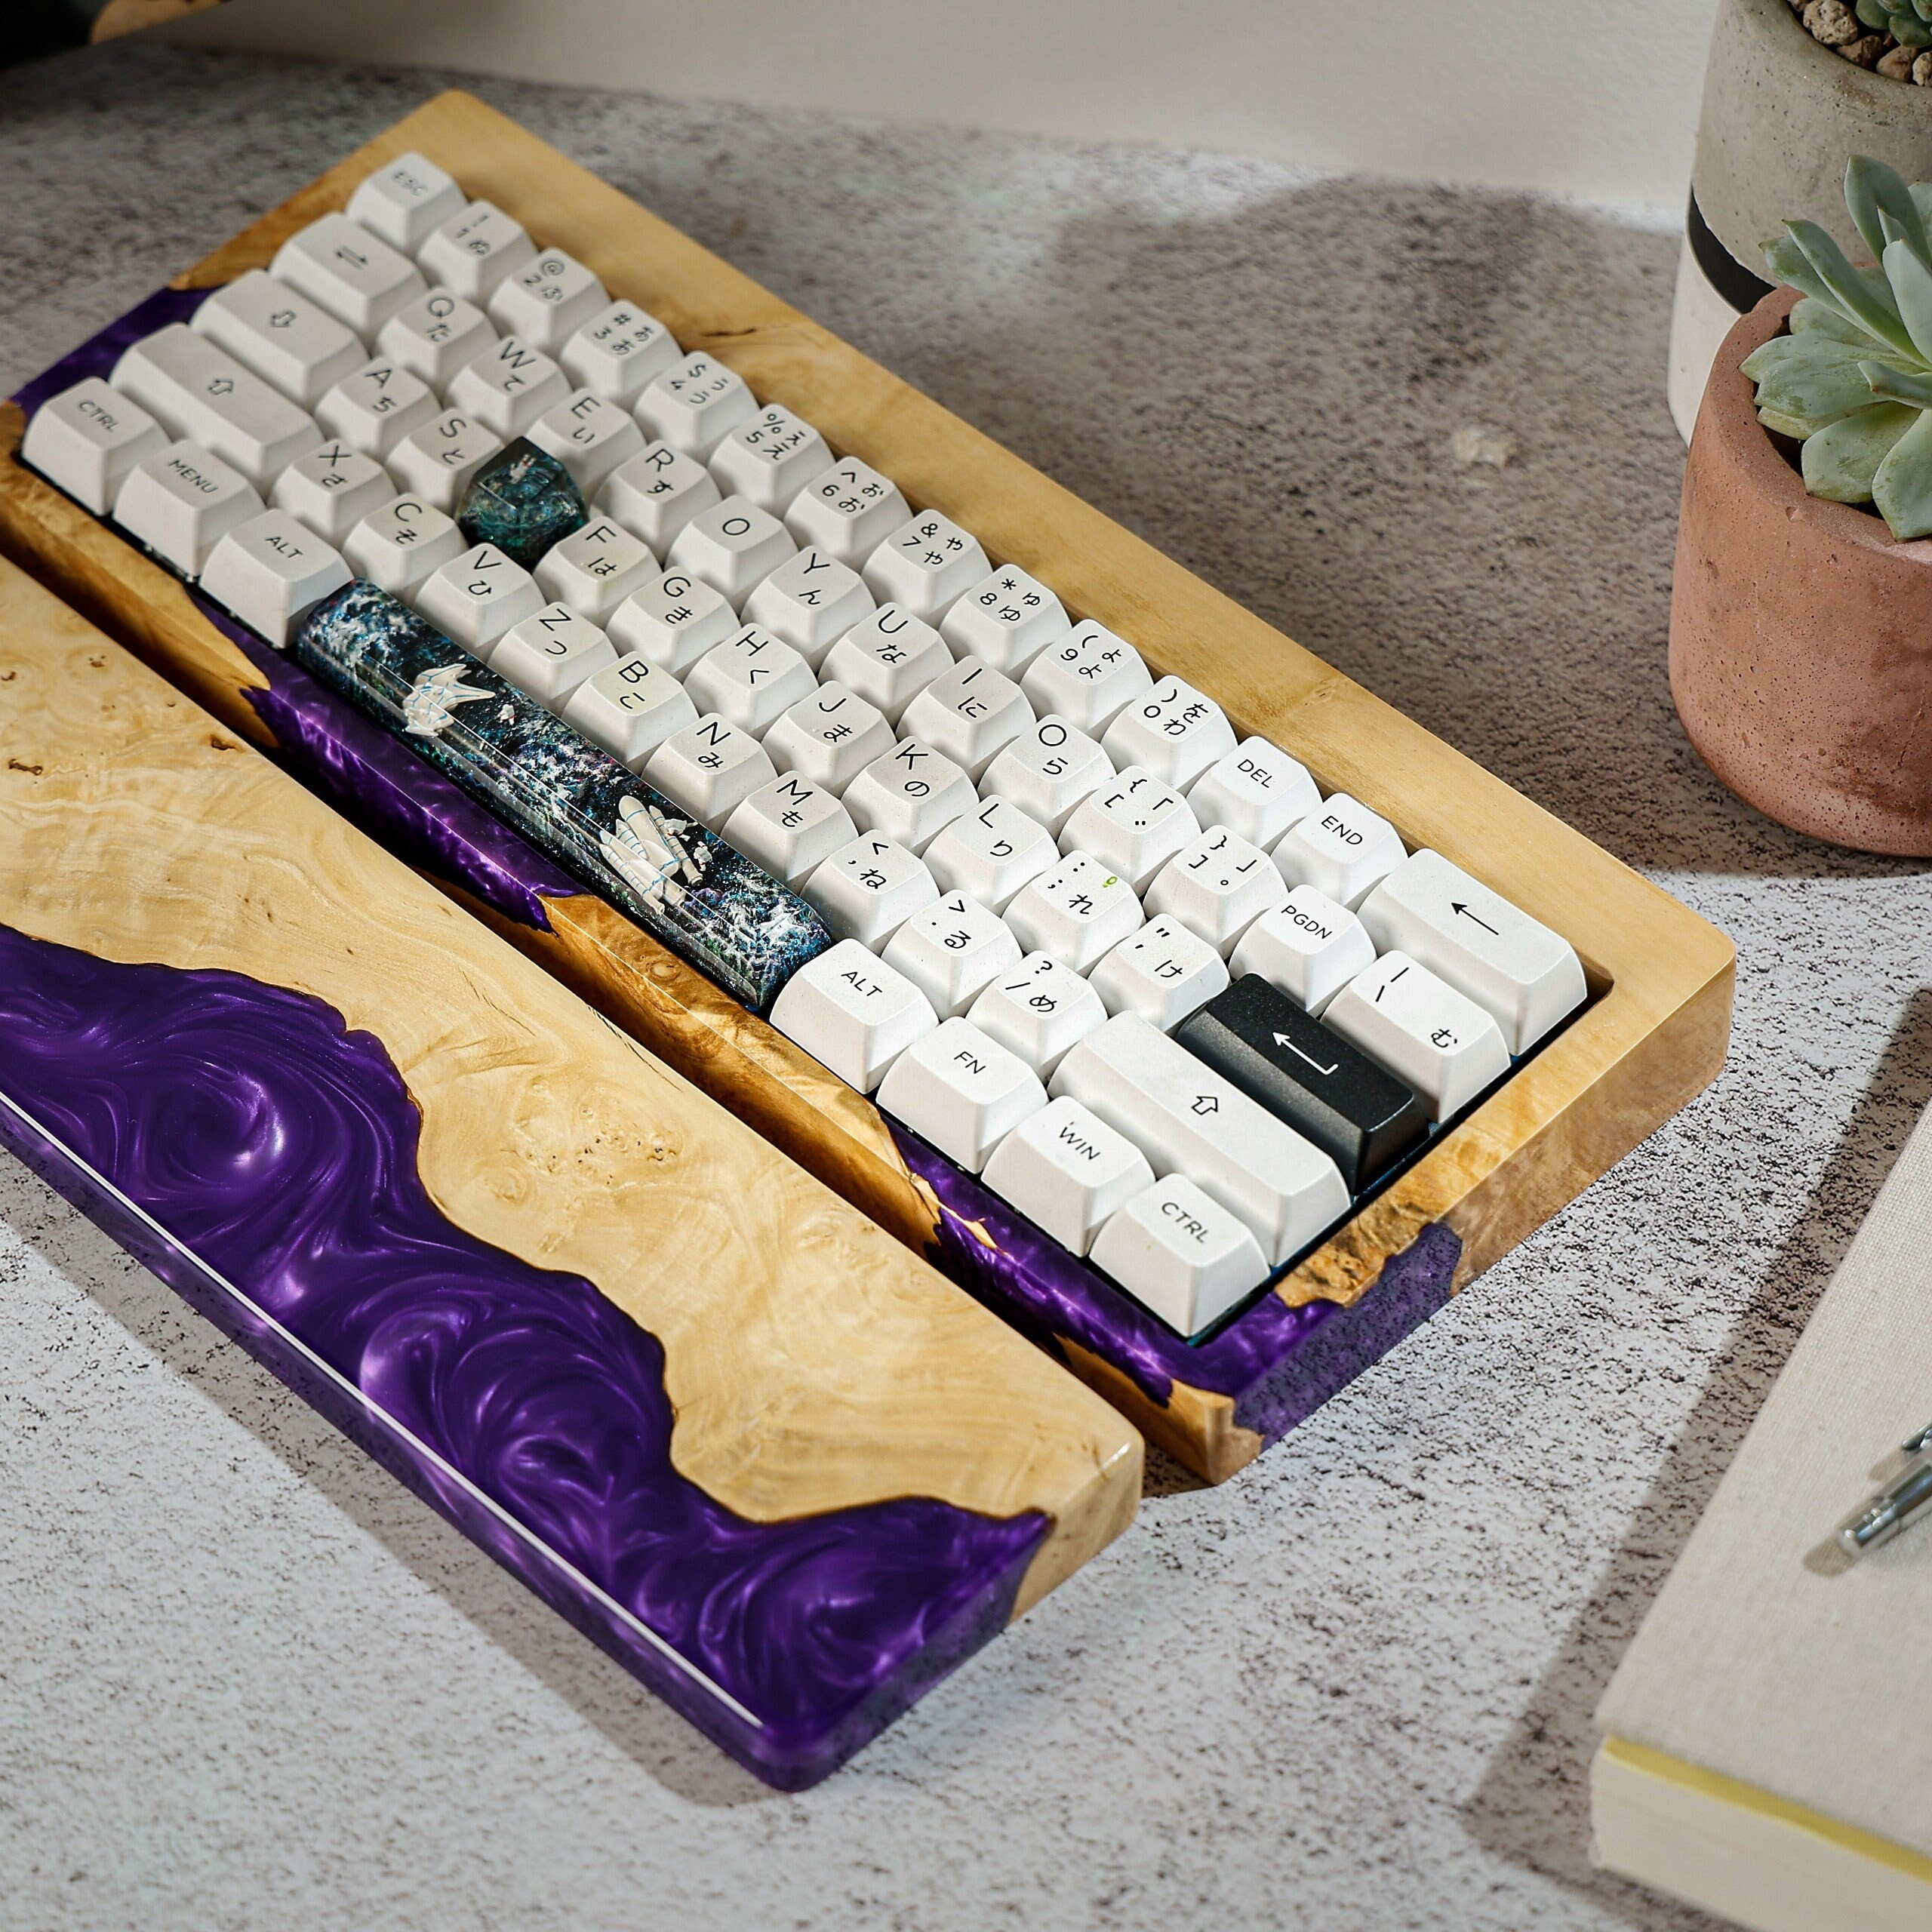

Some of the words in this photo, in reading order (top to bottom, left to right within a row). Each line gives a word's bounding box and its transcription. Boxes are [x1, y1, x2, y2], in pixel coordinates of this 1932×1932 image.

[524, 275, 541, 285] 2
[427, 297, 454, 318] Q
[614, 314, 631, 325] #
[594, 328, 612, 339] 3
[500, 341, 536, 369] W
[365, 369, 392, 388] A
[689, 365, 706, 377] $
[503, 375, 525, 391] て
[671, 381, 685, 389] 4
[78, 401, 118, 431] CTRL
[571, 397, 600, 419] E
[439, 418, 466, 438] S
[763, 414, 785, 433] %
[573, 428, 595, 444] い
[746, 431, 764, 443] 5
[318, 445, 351, 467] X
[441, 449, 464, 464] と
[645, 449, 674, 472] R
[168, 460, 217, 493] MENU
[322, 474, 346, 487] さ
[648, 481, 673, 494] す
[823, 485, 839, 497] 6
[395, 503, 422, 521] C
[586, 526, 616, 543] F
[921, 524, 937, 537] &
[266, 537, 303, 558] ALT
[903, 536, 921, 546] 7
[474, 551, 501, 569] V
[588, 558, 616, 576] は
[804, 553, 830, 574] Y
[469, 581, 491, 595] ひ
[663, 577, 691, 597] G
[798, 590, 821, 605] ん
[980, 593, 997, 605] 8
[539, 609, 571, 631] Z
[666, 607, 692, 624] き
[878, 610, 908, 633] U
[546, 641, 567, 654] つ
[736, 631, 768, 656] H
[1082, 635, 1098, 648] (
[876, 645, 906, 663] な
[1060, 649, 1078, 660] 9
[619, 660, 648, 683] B
[620, 693, 645, 709] こ
[1161, 689, 1177, 702] )
[819, 698, 846, 712] J
[958, 697, 987, 718] に
[1183, 704, 1208, 724] を
[697, 722, 731, 746] N
[823, 724, 853, 743] ま
[1038, 724, 1066, 746] O
[1164, 719, 1186, 735] わ
[698, 752, 723, 768] み
[895, 744, 928, 770] K
[1043, 758, 1068, 774] ら
[1238, 759, 1272, 788] DEL
[777, 780, 813, 805] M
[905, 781, 930, 796] の
[1104, 794, 1124, 808] [
[782, 811, 803, 827] も
[979, 804, 998, 828] L
[1321, 816, 1362, 844] END
[1189, 854, 1208, 869] ]
[860, 869, 886, 889] ね
[1069, 894, 1093, 915] れ
[1281, 905, 1332, 939] PGDN
[944, 931, 971, 949] る
[1035, 961, 1052, 974] ?
[1155, 960, 1183, 977] け
[841, 972, 882, 996] ALT
[1029, 995, 1057, 1012] め
[1431, 1029, 1457, 1048] む
[954, 1051, 986, 1074] FN
[1060, 1127, 1100, 1160] WIN
[1161, 1202, 1208, 1243] CTRL
